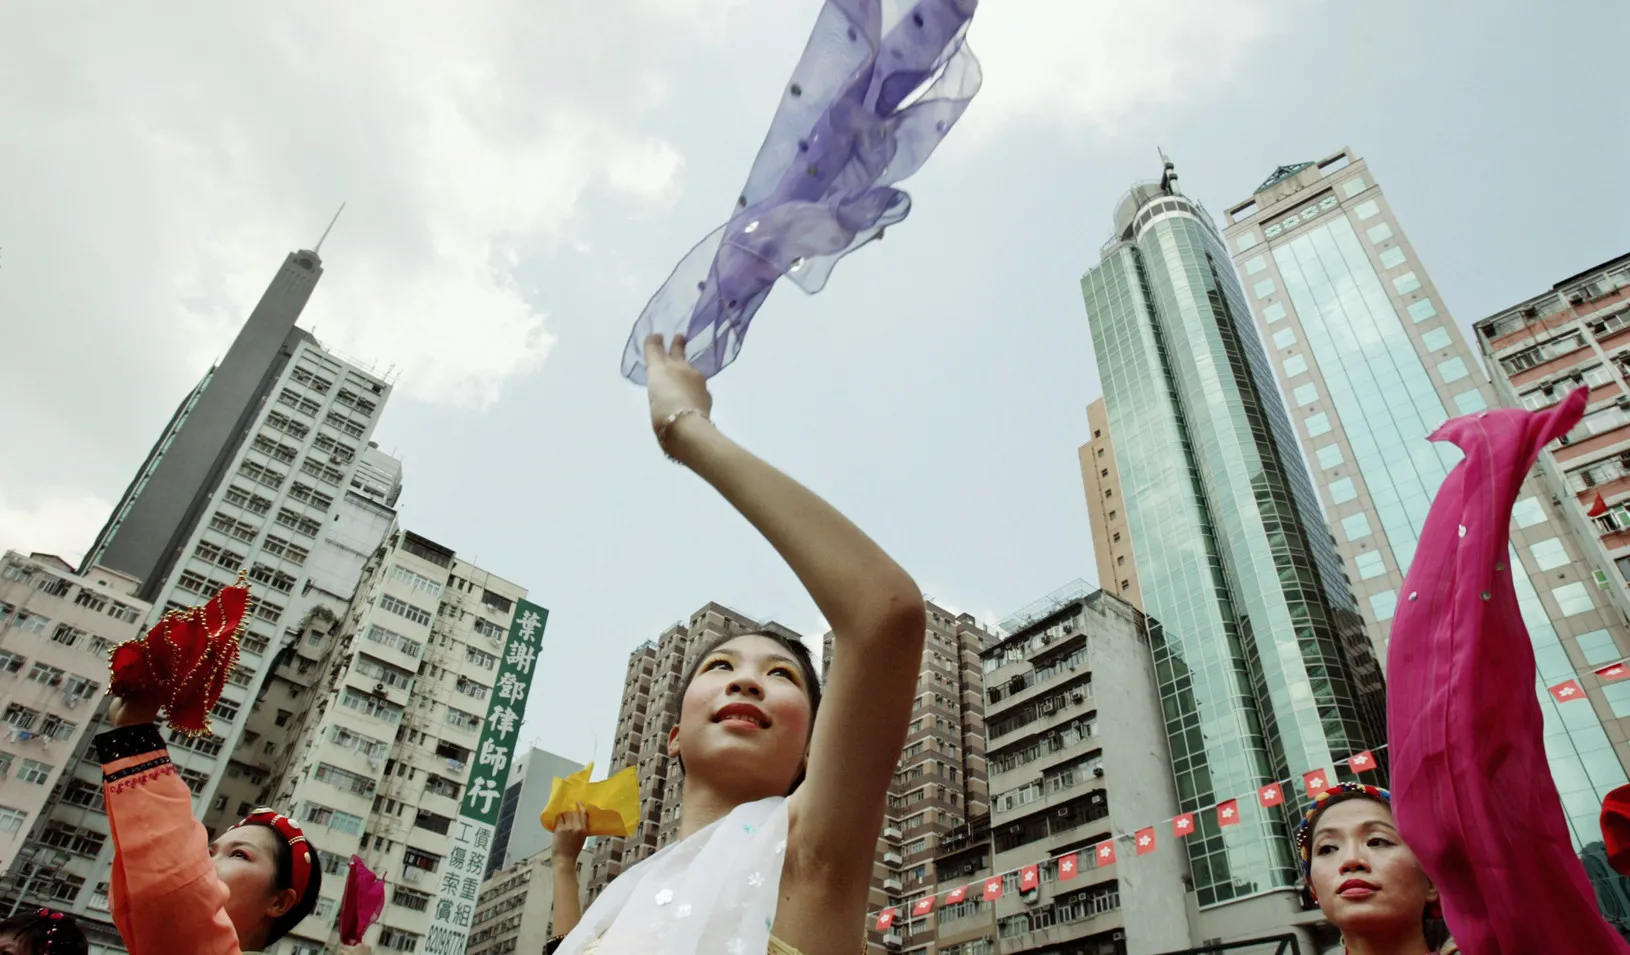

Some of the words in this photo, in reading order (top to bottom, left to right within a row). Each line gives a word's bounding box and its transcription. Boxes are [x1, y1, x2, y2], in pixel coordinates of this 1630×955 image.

[467, 610, 542, 814] 葉謝鄧律師行
[434, 821, 473, 923] 工傷索償
[452, 826, 491, 927] 債務重組
